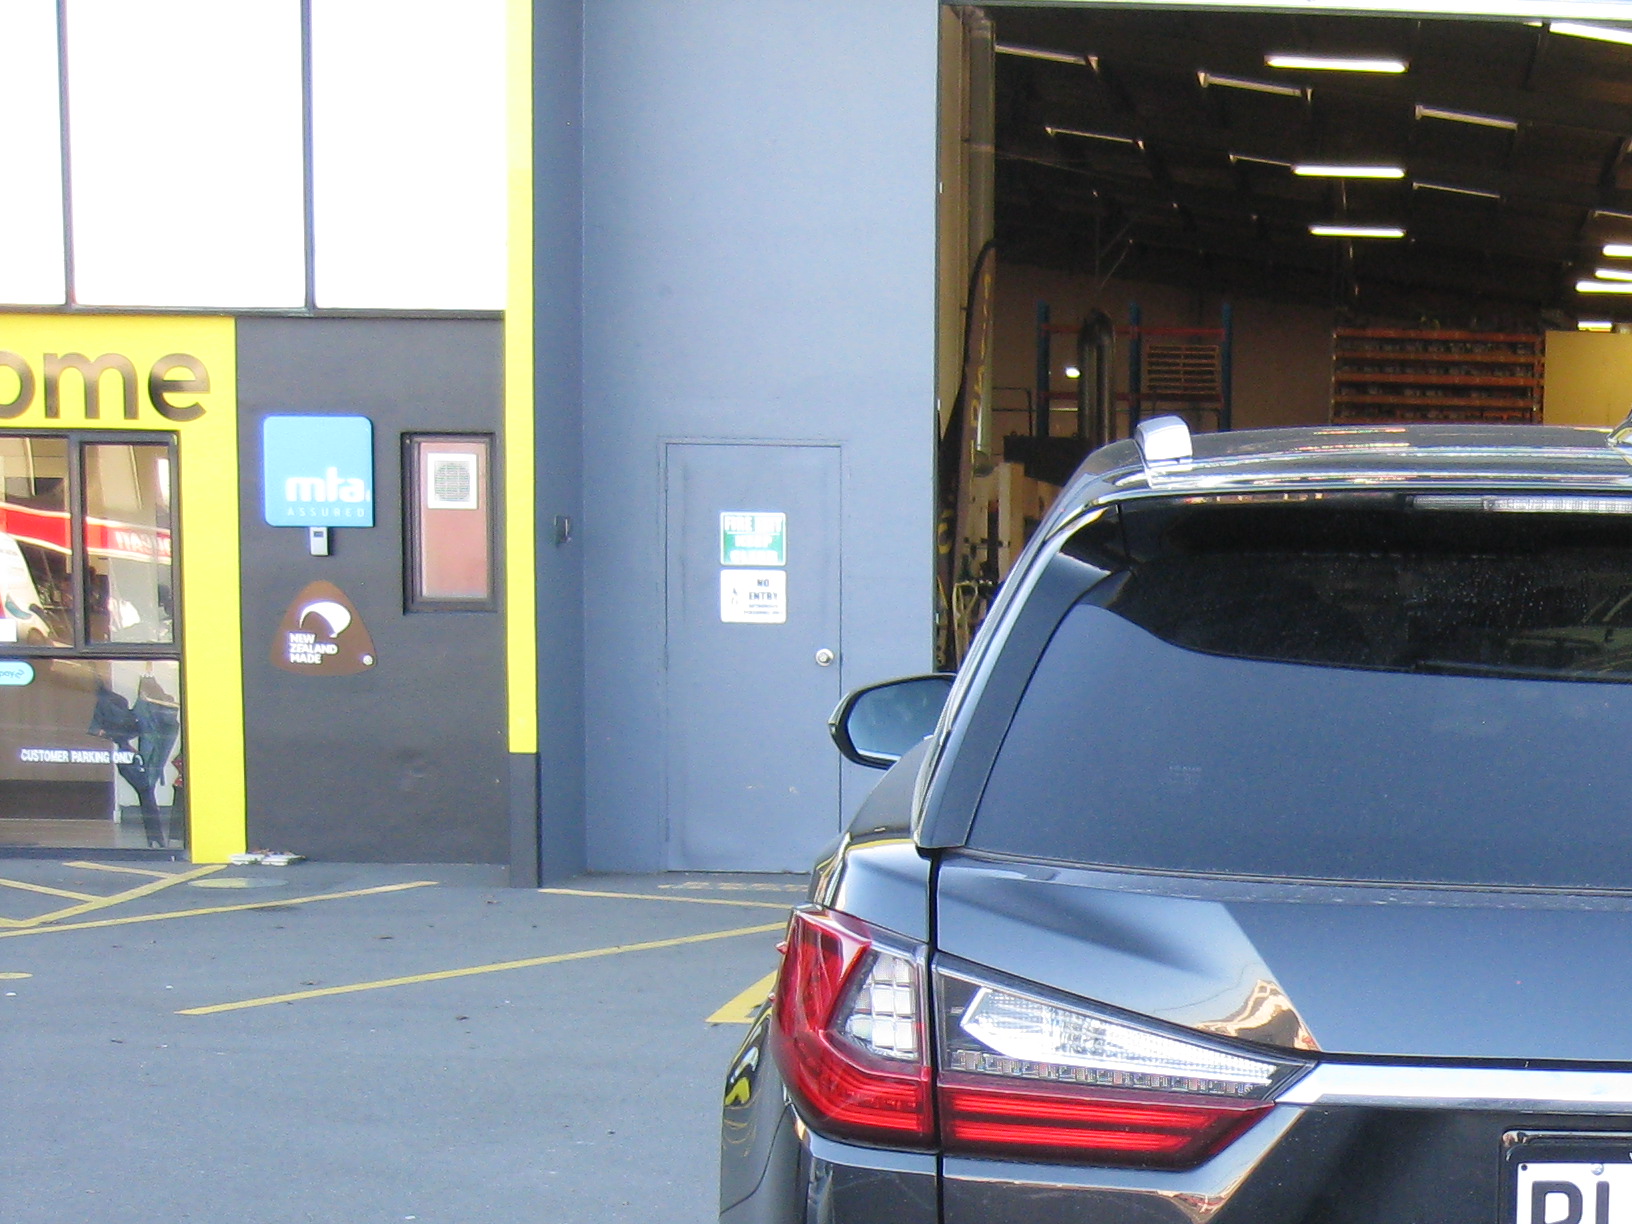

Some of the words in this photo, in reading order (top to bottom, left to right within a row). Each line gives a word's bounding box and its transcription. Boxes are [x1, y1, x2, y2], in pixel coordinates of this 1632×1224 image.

[287, 506, 365, 518] ASSURED
[757, 579, 770, 587] NO
[749, 592, 778, 601] ENTRY
[290, 632, 316, 643] NEW
[290, 643, 338, 654] ZEALAND
[290, 653, 322, 664] MADE
[21, 748, 69, 762] CUSTOMER
[71, 750, 111, 764] PARKING
[113, 751, 136, 764] ONLY
